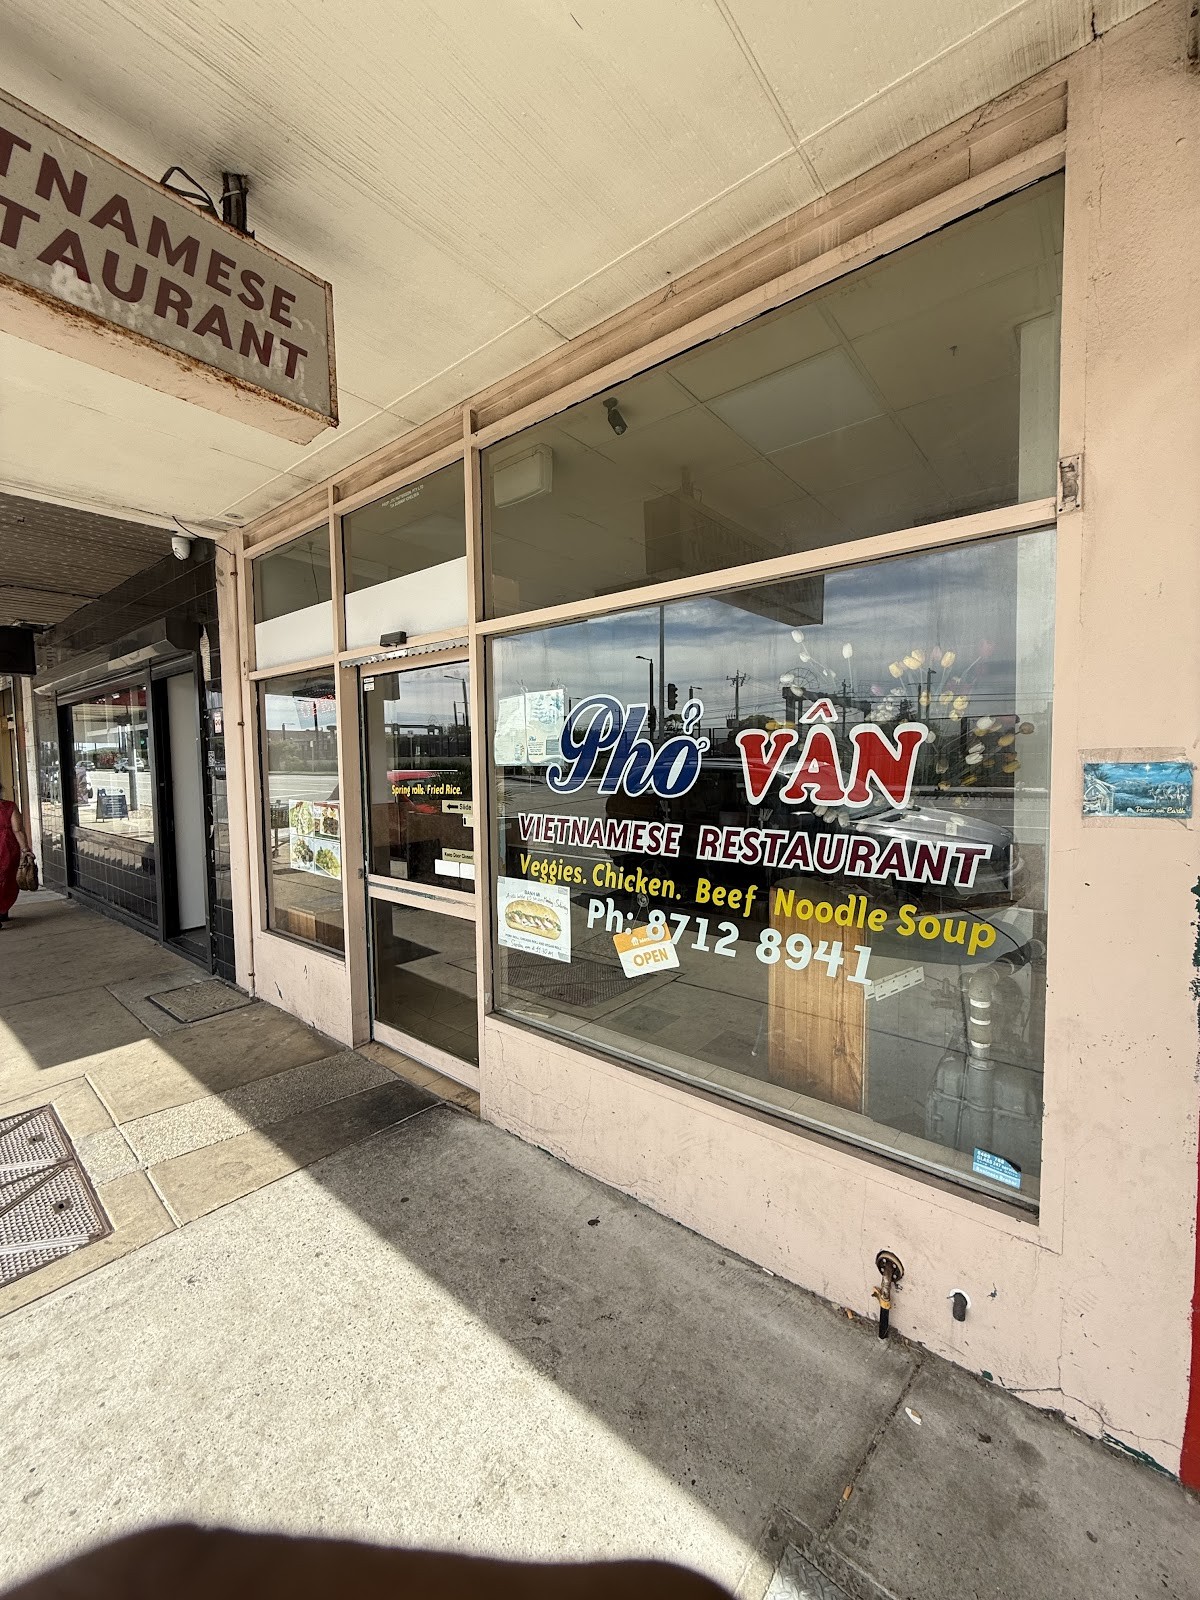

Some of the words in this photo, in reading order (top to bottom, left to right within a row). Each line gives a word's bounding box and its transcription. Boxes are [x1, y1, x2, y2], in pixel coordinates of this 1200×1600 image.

[0, 127, 296, 328] TNAMESE
[0, 195, 308, 380] TAURANT
[391, 784, 410, 797] Spring
[411, 783, 426, 795] rolls.
[427, 783, 444, 795] Fried
[445, 784, 463, 795] Rice.
[736, 698, 928, 809] VÂN
[518, 812, 683, 857] VIETNAMESE
[696, 825, 993, 888] RESTAURANT
[520, 853, 587, 885] Veggies.
[592, 862, 682, 900] Chicken.
[695, 878, 758, 918] Beef
[773, 888, 888, 932] Noodle
[896, 904, 997, 956] Soup
[587, 897, 634, 935] Ph:
[646, 909, 740, 957] 8712
[756, 927, 873, 985] 8941
[633, 948, 669, 967] OPEN
